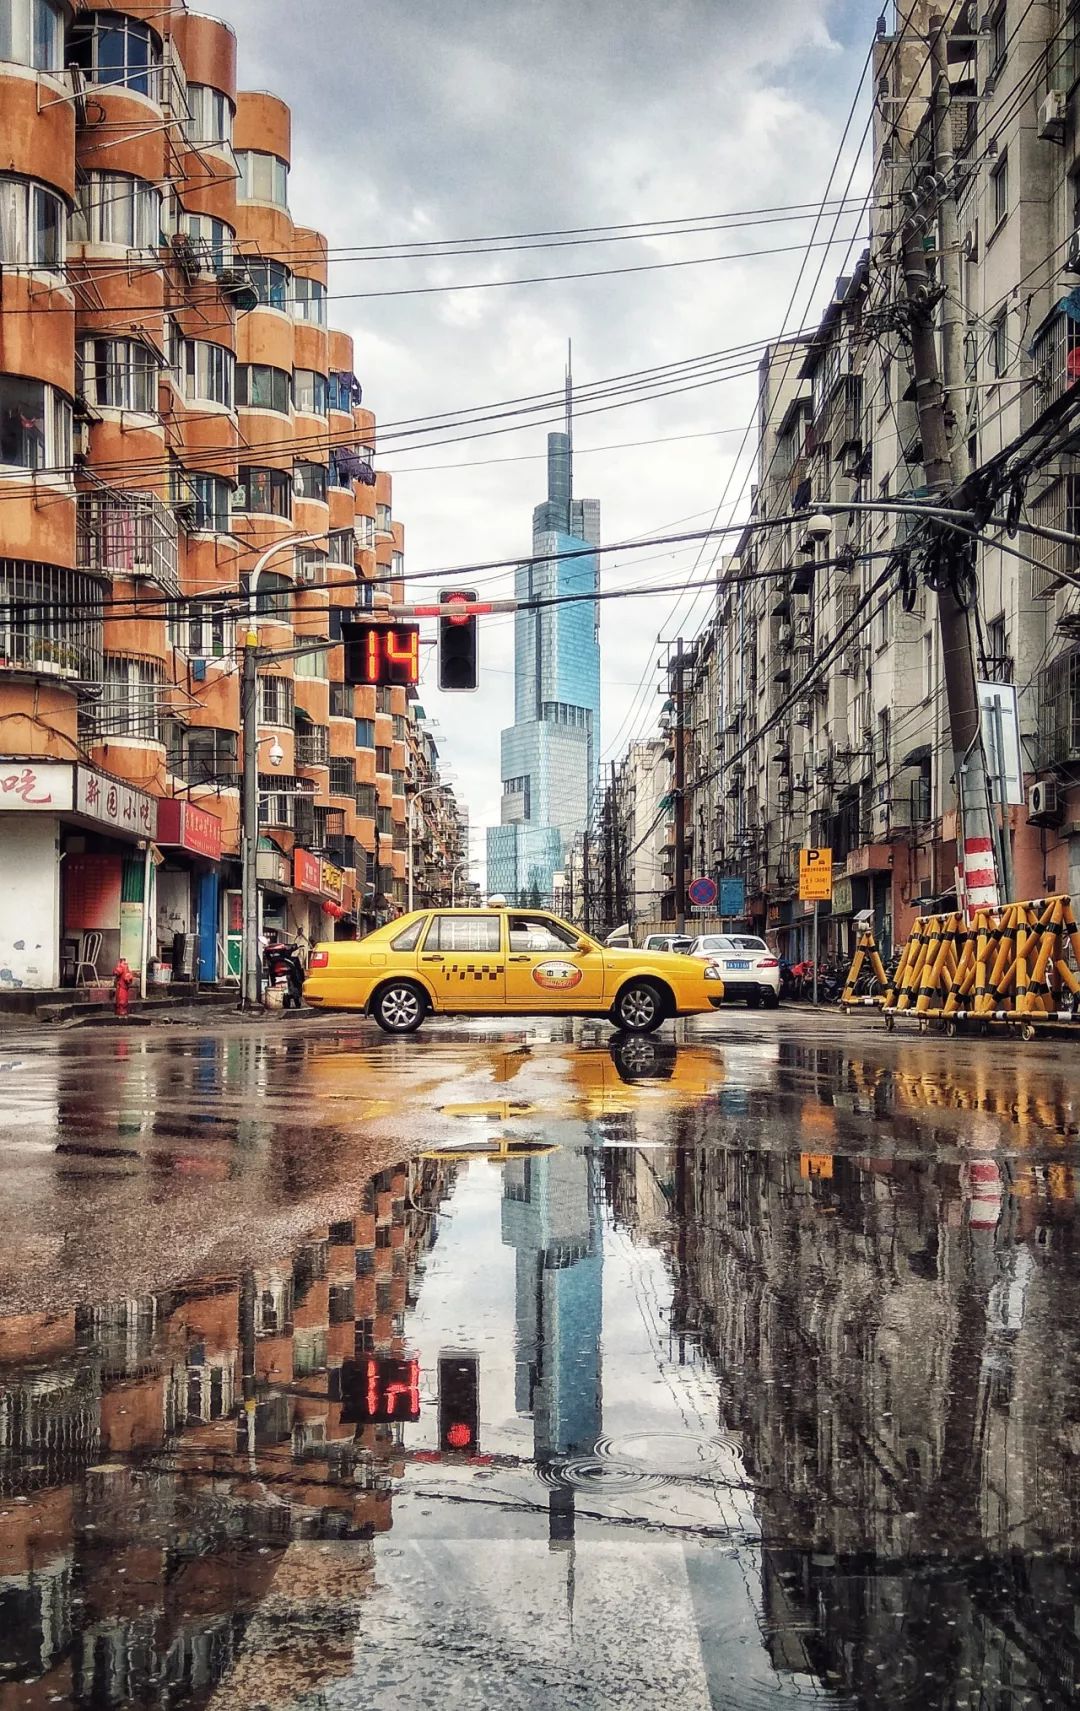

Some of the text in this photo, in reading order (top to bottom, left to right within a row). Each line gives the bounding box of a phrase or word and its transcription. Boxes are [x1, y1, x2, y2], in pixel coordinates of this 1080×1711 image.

[367, 630, 418, 681] 14
[0, 768, 51, 804] 吃
[807, 850, 820, 866] P
